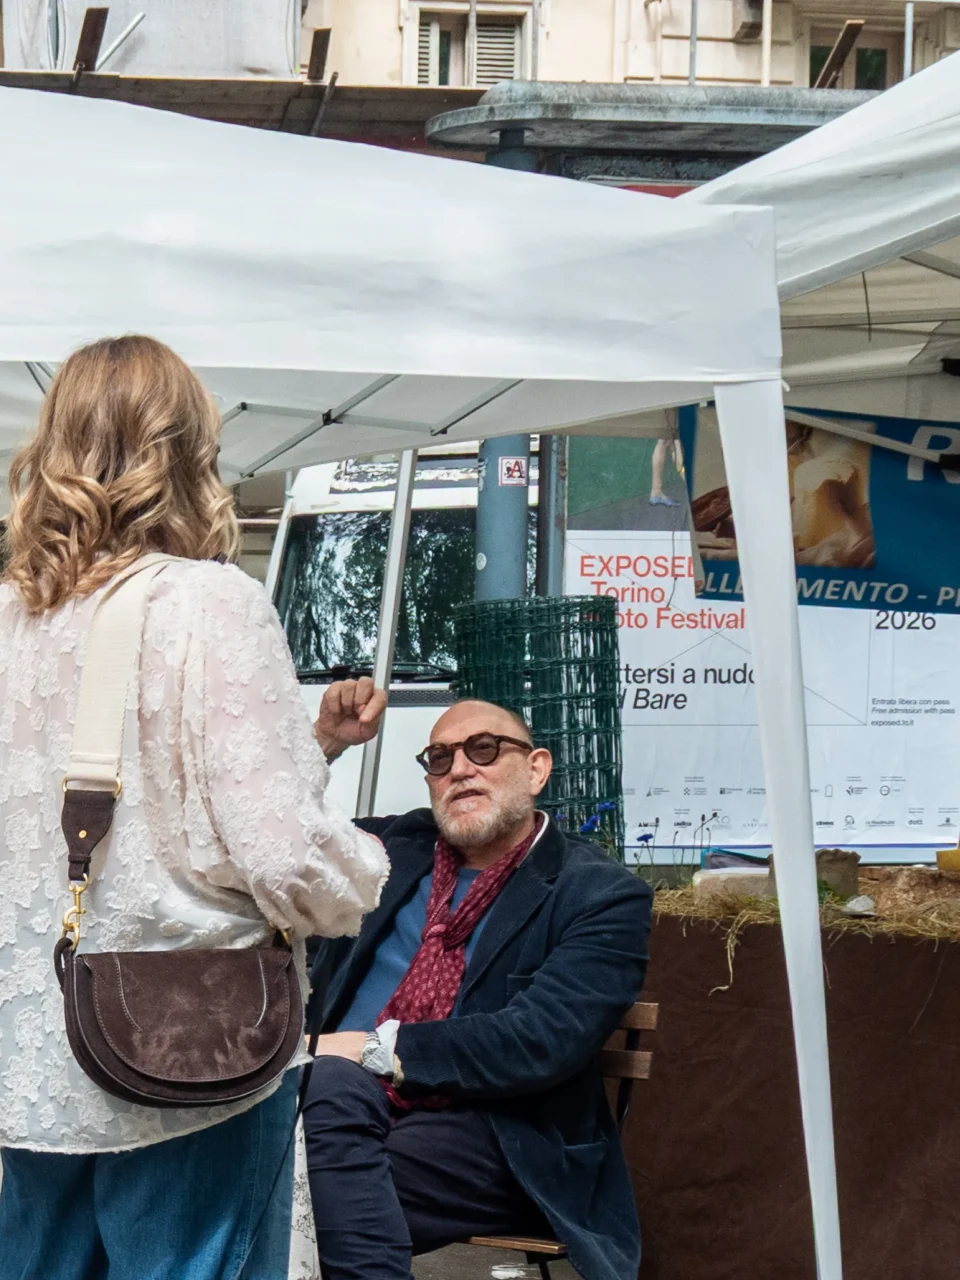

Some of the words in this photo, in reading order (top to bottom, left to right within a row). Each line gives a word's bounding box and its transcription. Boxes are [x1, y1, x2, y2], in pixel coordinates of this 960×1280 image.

[590, 581, 665, 603] Torino
[656, 608, 745, 629] Festival
[875, 611, 937, 630] 2026
[683, 668, 695, 684] a
[632, 688, 688, 710] Bare
[871, 719, 914, 727] exposed.to.it
